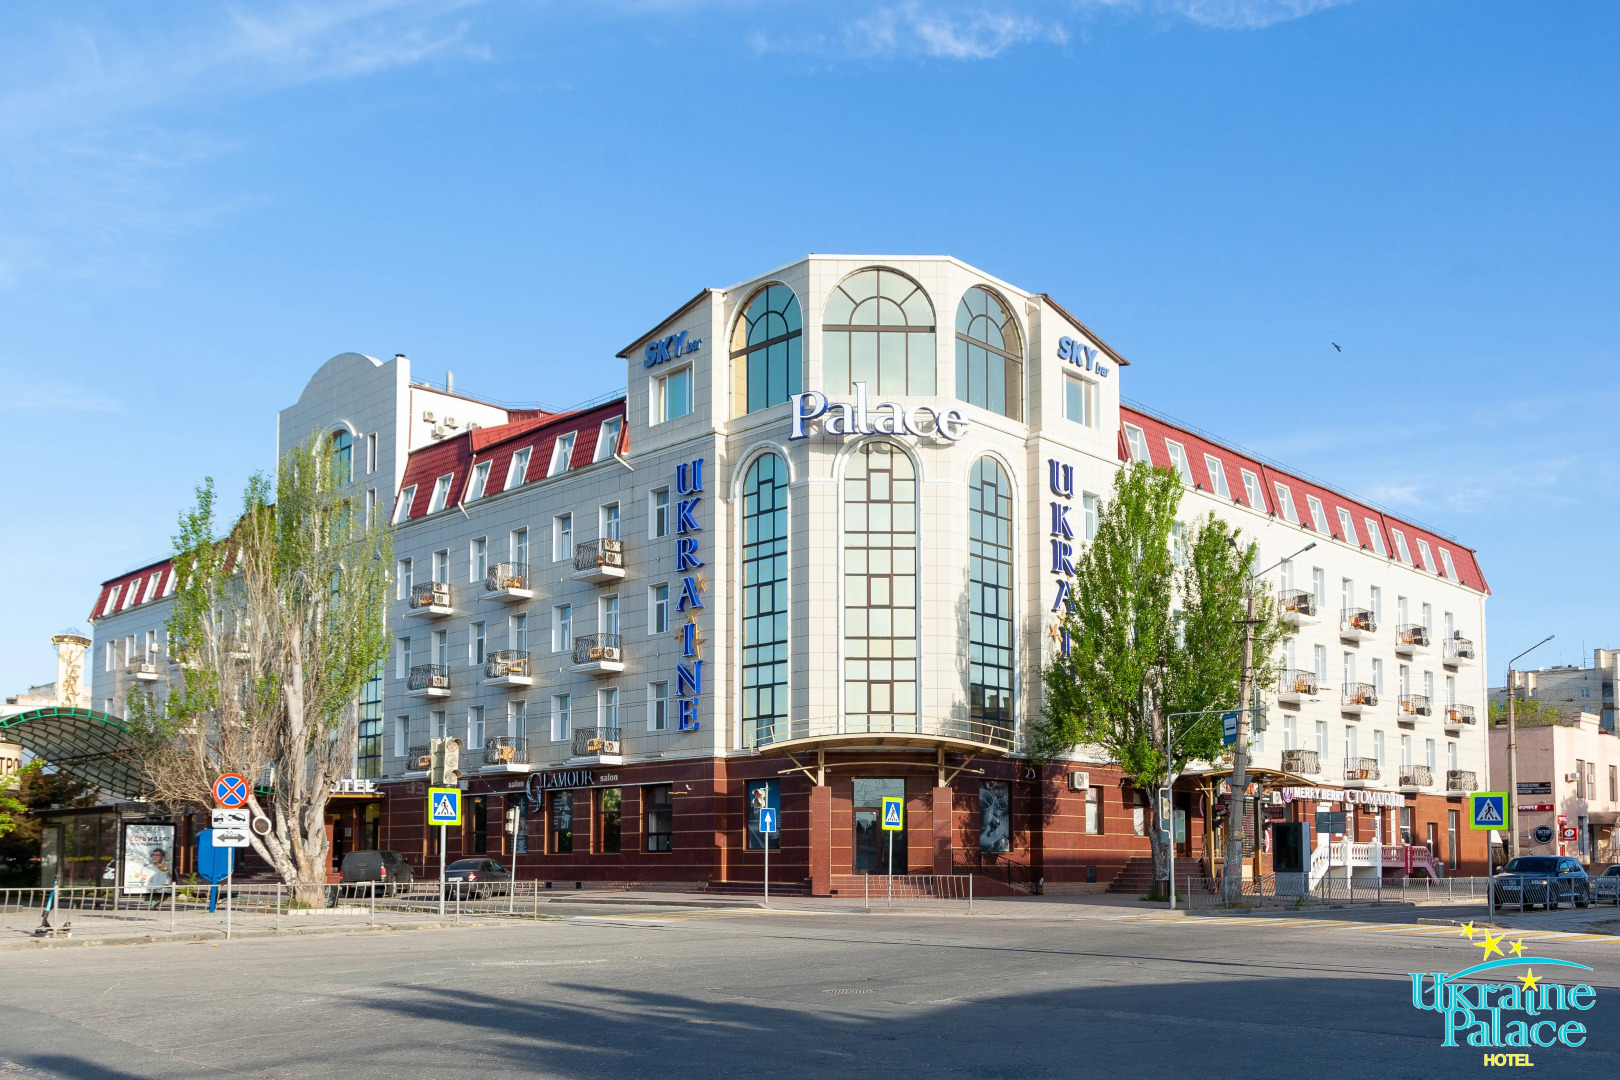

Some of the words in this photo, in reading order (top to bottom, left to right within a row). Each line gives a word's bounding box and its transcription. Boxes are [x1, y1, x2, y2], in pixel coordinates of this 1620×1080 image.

[643, 329, 688, 368] SKY
[686, 338, 703, 353] bar
[1057, 335, 1098, 371] SKY
[1095, 362, 1110, 378] bar
[788, 381, 970, 441] Palace
[675, 458, 705, 732] UKRAINE
[508, 780, 524, 788] salon
[526, 770, 595, 813] GLAMOUR
[600, 773, 618, 782] salon
[1294, 786, 1320, 799] MERRY
[1322, 789, 1344, 801] BERRY
